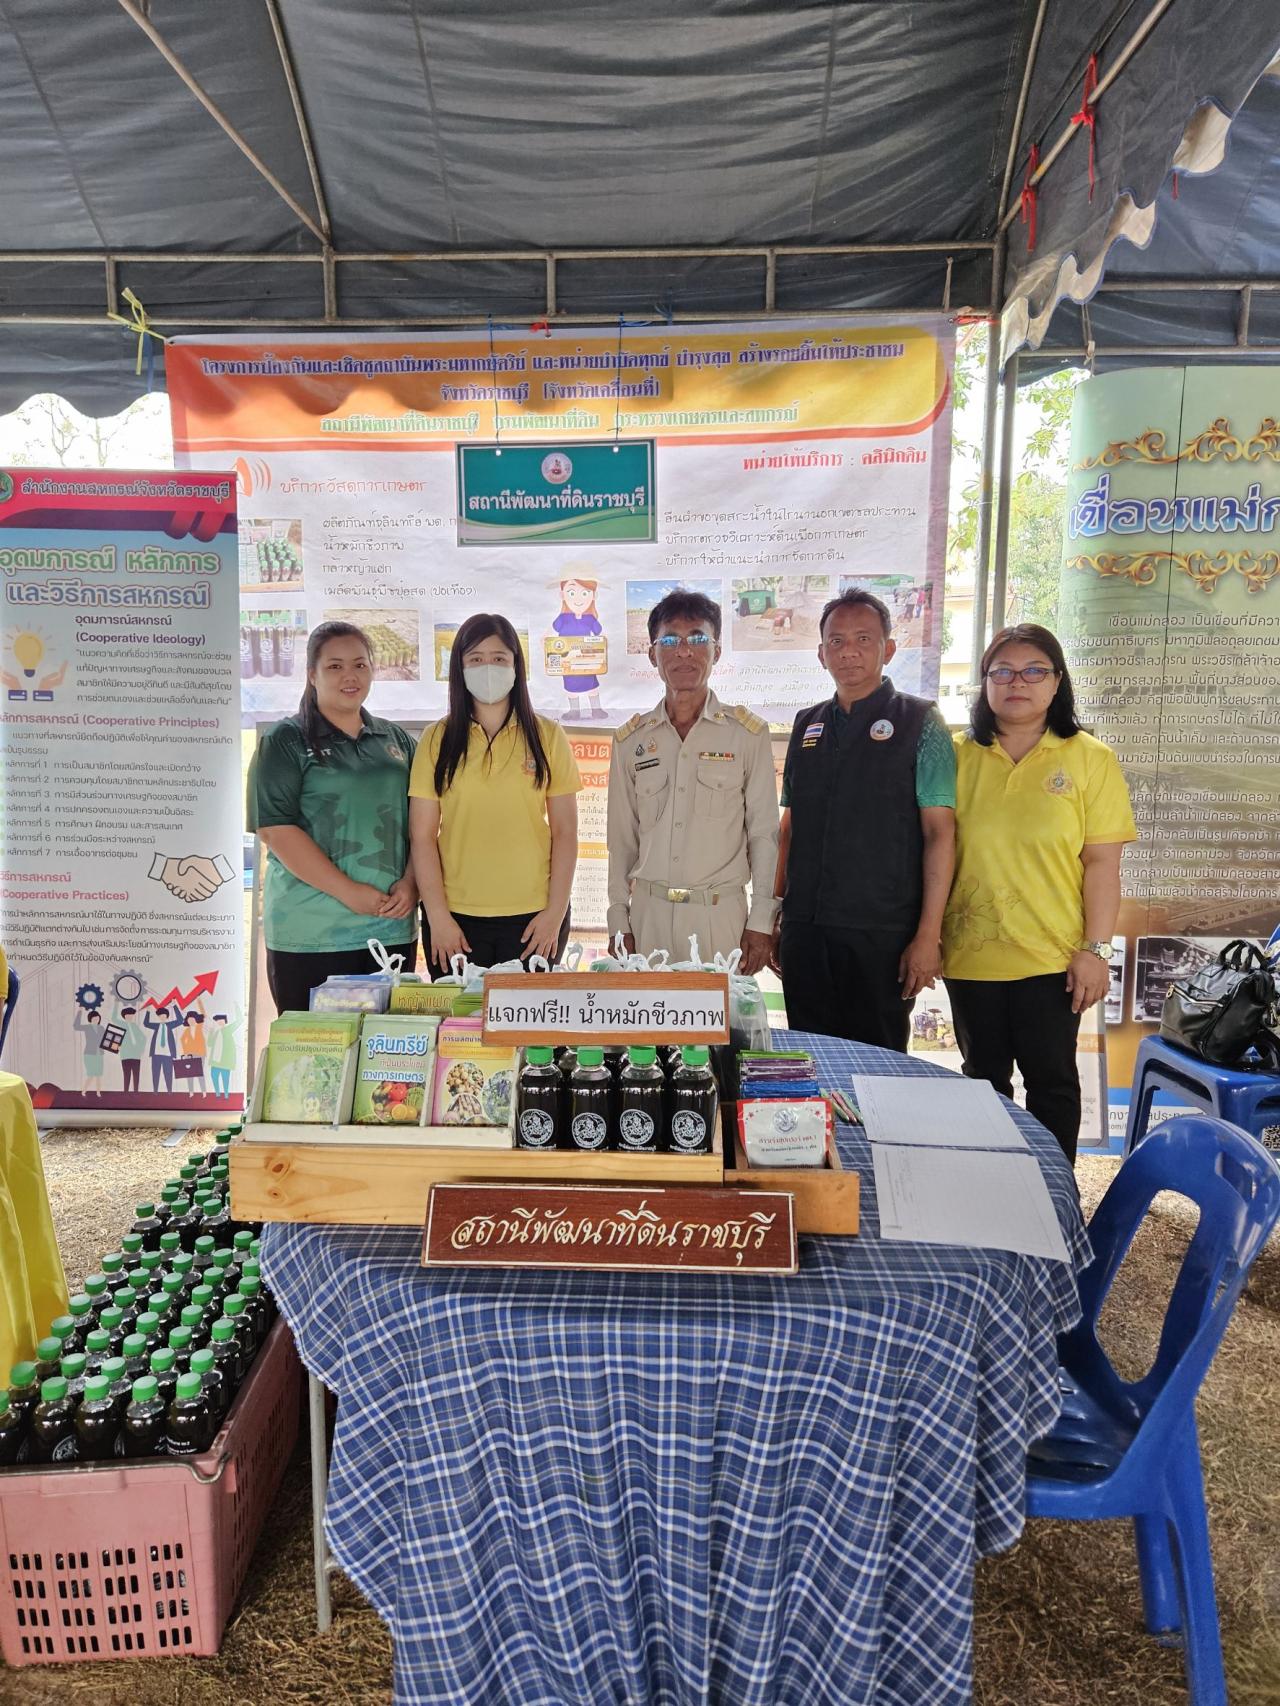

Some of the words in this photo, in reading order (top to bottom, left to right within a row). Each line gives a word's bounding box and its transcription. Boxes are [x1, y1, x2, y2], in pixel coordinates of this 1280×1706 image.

[440, 383, 530, 404] จังหวัดราชบุรี
[21, 478, 231, 503] สำนักงานสหกรณ์จังหวัดราชบุรี
[468, 484, 646, 514] สถานีพัฒนาที่ดินราชบุรี
[125, 545, 220, 573] หลักการ
[7, 578, 211, 609] และวิธีการสหกรณ์
[75, 614, 172, 627] อุดมการณ์สหกรณ์
[1109, 611, 1185, 627] เขื่อนแม่กลอง
[76, 631, 149, 645] (Cooperative
[153, 633, 206, 647] Ideology)
[83, 714, 157, 728] (Cooperative
[159, 716, 220, 729] Principles)
[72, 890, 129, 901] Practices)
[488, 1001, 570, 1025] แจกฟรี!!
[579, 992, 724, 1027] น้ำหมักชีวภาพ
[366, 1034, 429, 1060] จุลินทรีย์
[450, 1199, 776, 1267] สถานีพัฒนาที่ดินราชบุรี
